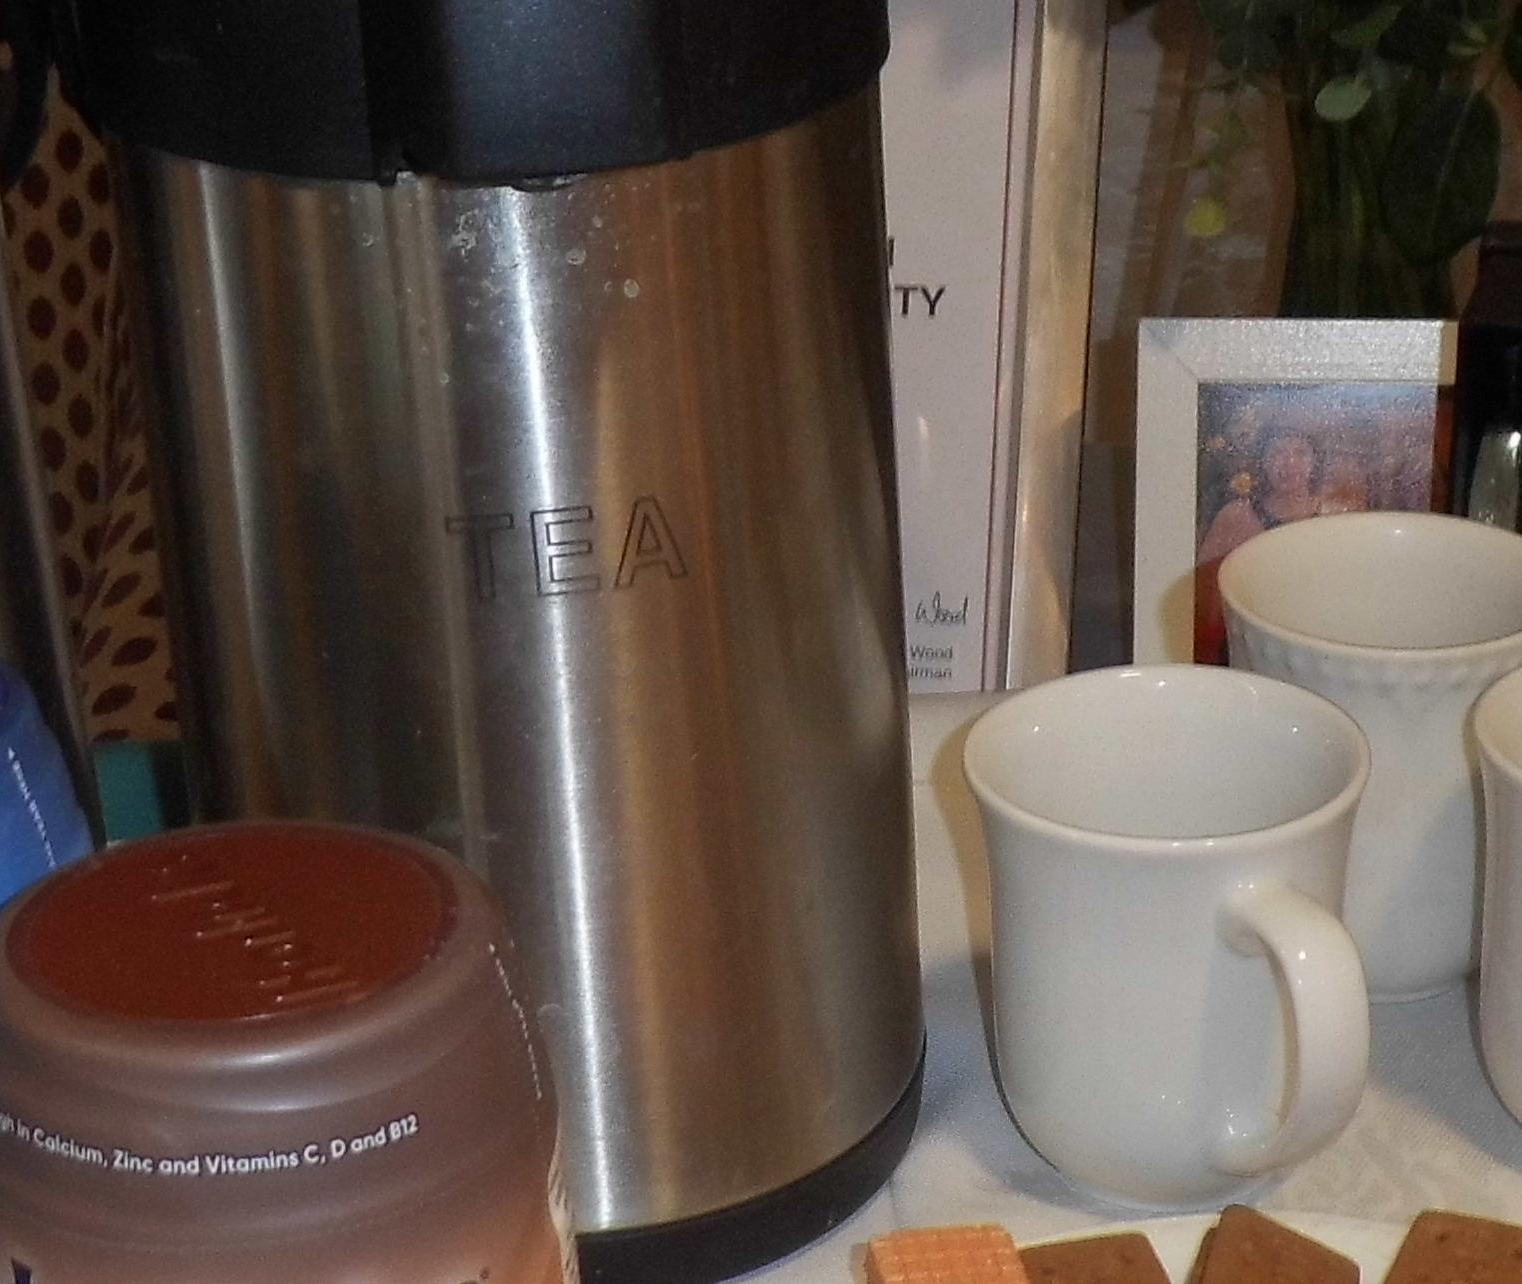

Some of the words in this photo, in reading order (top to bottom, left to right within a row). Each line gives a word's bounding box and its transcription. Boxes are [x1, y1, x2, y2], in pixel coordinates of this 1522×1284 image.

[445, 495, 689, 600] TEA
[17, 1118, 30, 1142] in
[33, 1128, 108, 1167] Calcium,
[113, 1148, 153, 1173] Zinc
[159, 1155, 200, 1175] and
[205, 1150, 299, 1175] Vitamins
[303, 1144, 326, 1166] C,
[331, 1138, 347, 1158] D
[350, 1127, 388, 1155] and
[390, 1113, 420, 1143] B12
